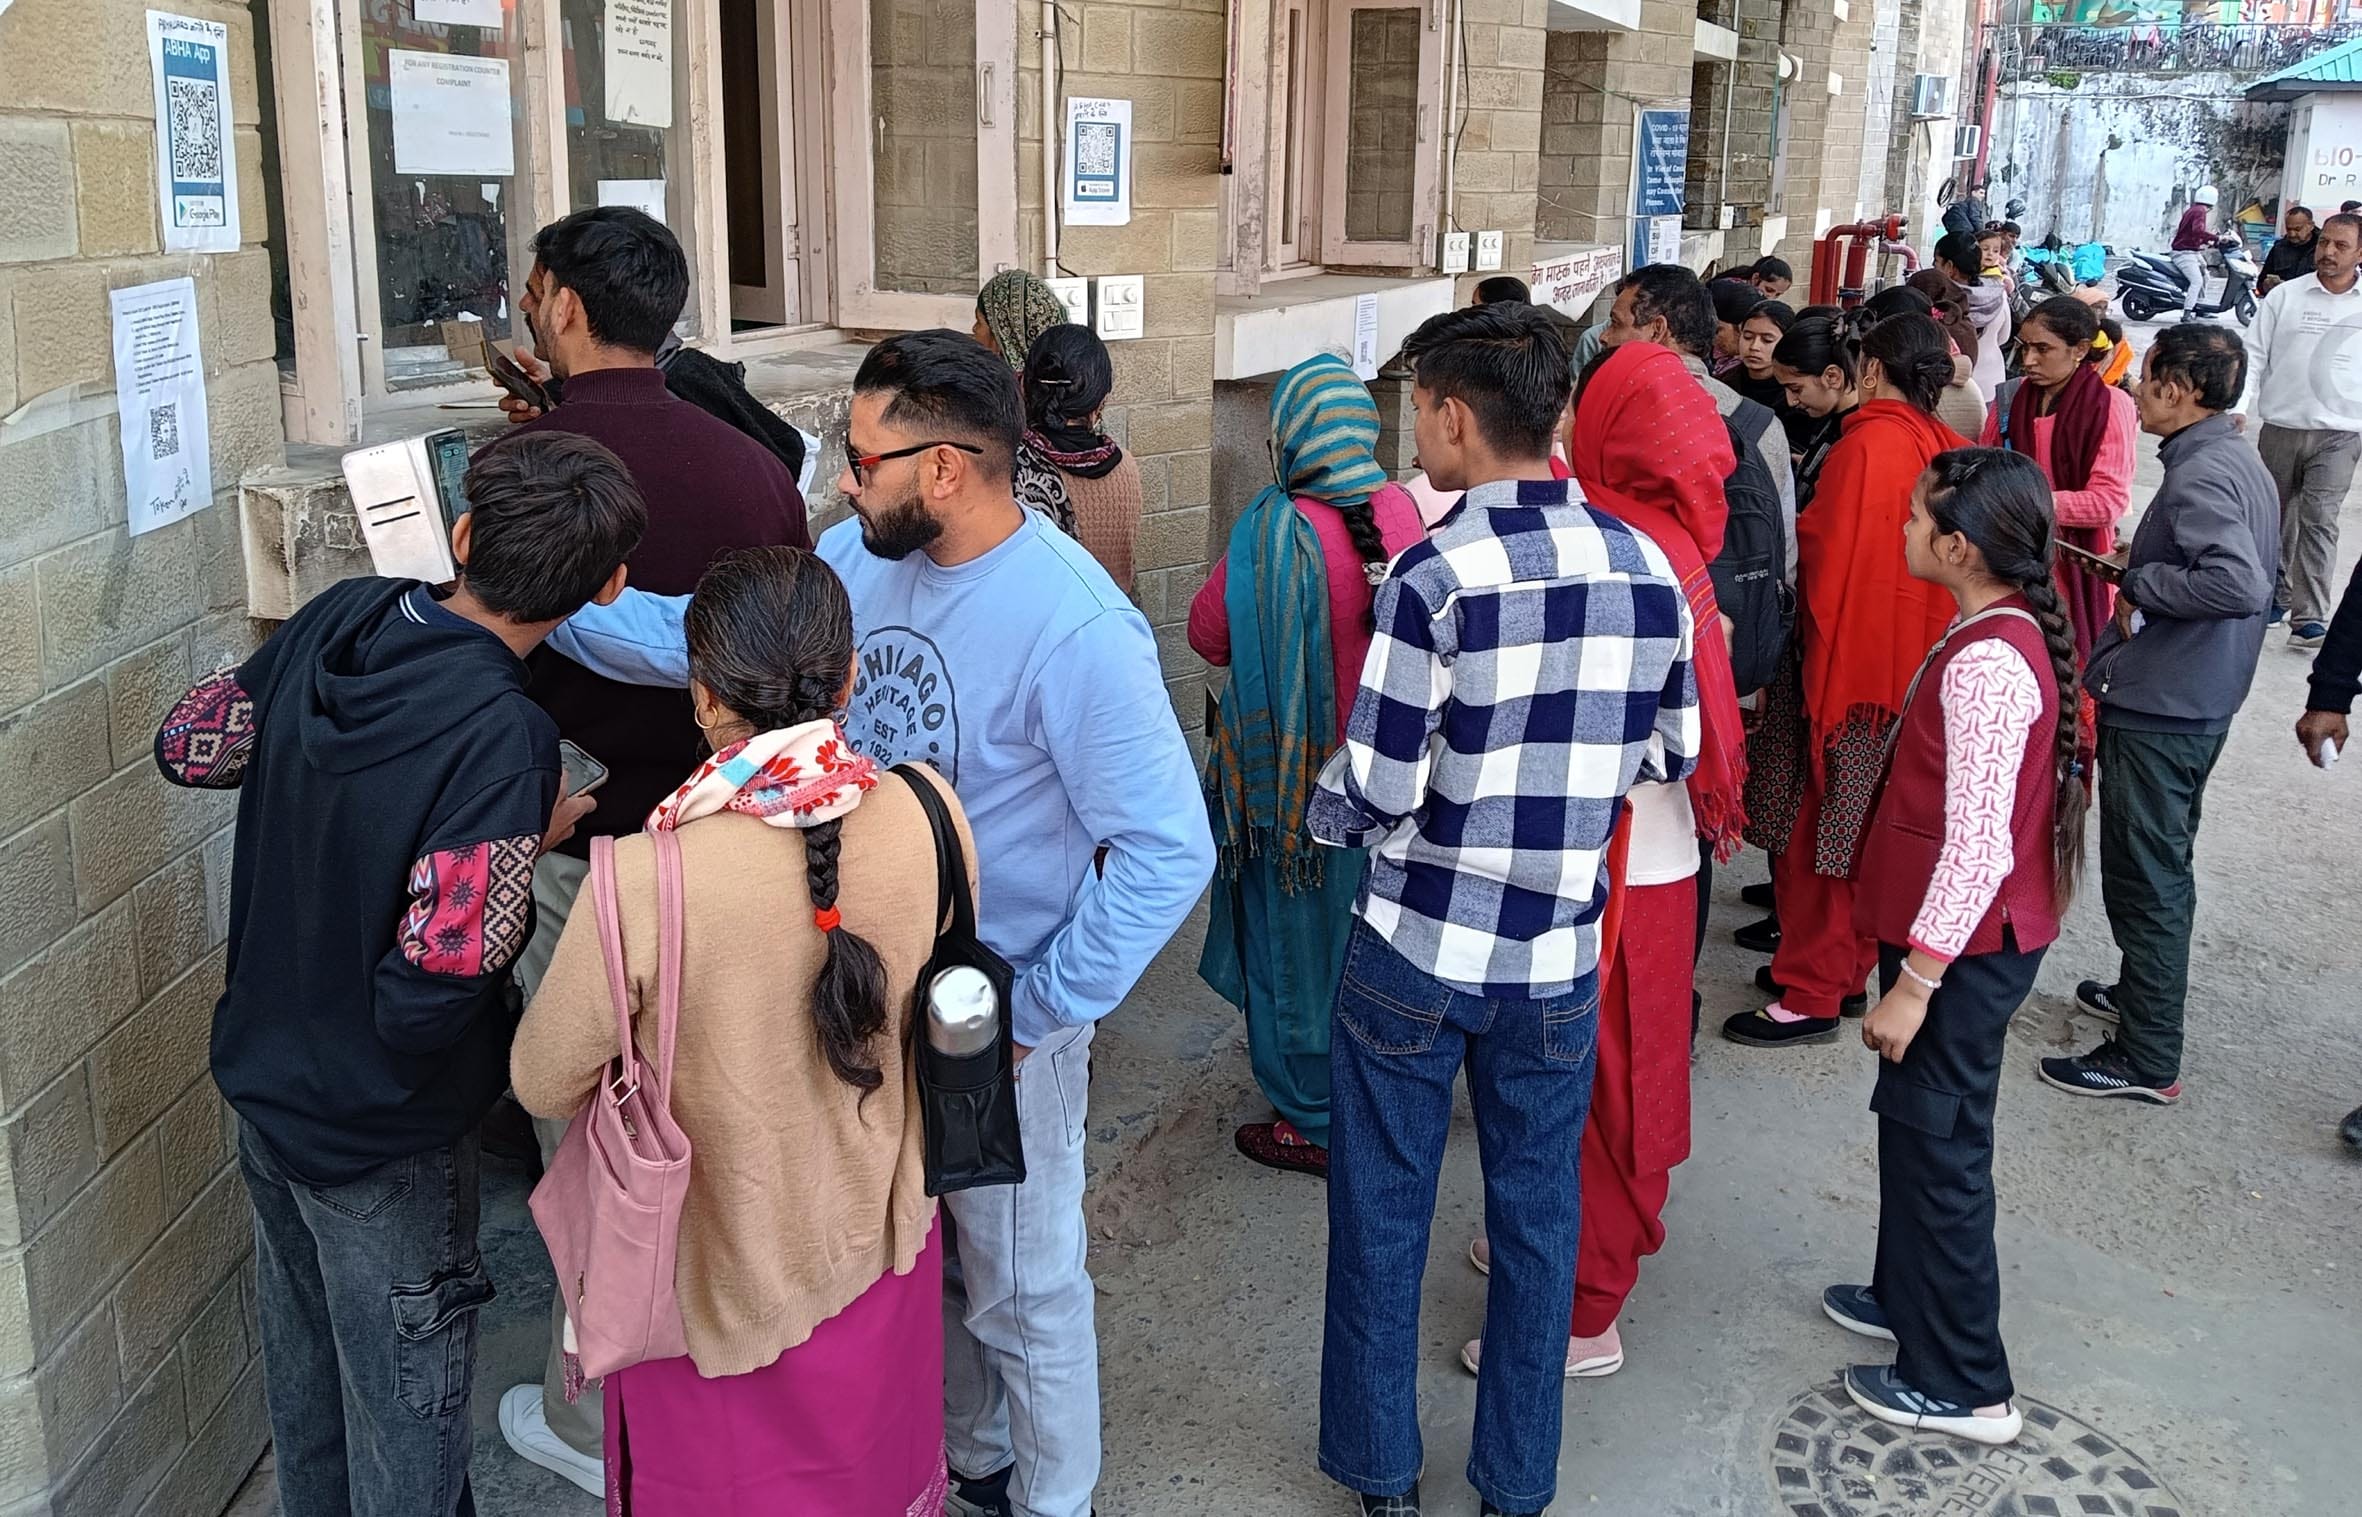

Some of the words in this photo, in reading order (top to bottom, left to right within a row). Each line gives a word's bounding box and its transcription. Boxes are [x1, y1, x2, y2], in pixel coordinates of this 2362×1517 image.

[164, 40, 193, 58] ABHA
[194, 45, 211, 65] App
[432, 62, 473, 73] REGISTRATION
[474, 67, 500, 76] COUNTER
[436, 77, 471, 88] COMPLAINT
[2318, 173, 2337, 186] Dr
[1546, 263, 1570, 283] मास्क
[1573, 253, 1590, 277] पहने
[853, 644, 946, 732] CHIAGO
[873, 718, 899, 744] EST
[869, 740, 893, 767] 1922
